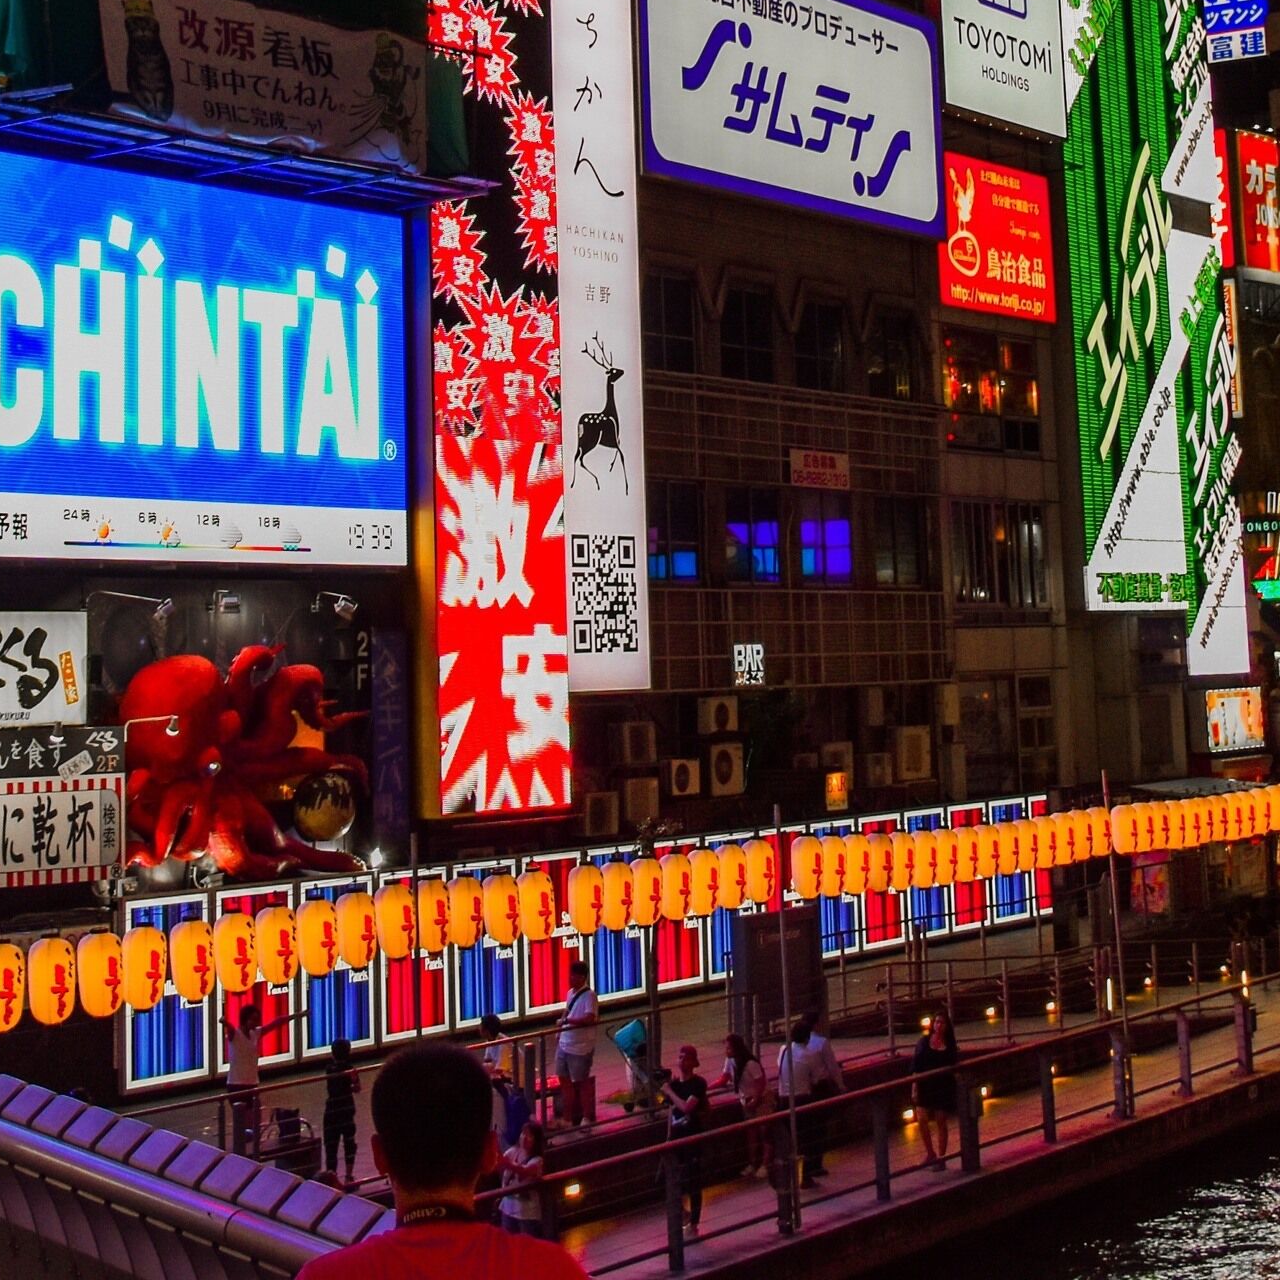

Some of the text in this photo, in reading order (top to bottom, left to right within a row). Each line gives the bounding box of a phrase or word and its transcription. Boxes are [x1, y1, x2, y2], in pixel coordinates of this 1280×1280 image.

[175, 5, 340, 81] 改源看板
[981, 64, 1030, 92] HOLDINGS
[723, 61, 875, 162] サムティ
[565, 223, 625, 245] HACHIKAN
[572, 246, 619, 264] YOSHINO
[584, 283, 612, 305] 吉野
[1086, 172, 1173, 409] エイブル
[63, 508, 91, 522] 24時
[196, 514, 221, 527] 12時
[257, 516, 282, 529] 18時
[733, 643, 765, 673] BAR
[97, 754, 120, 773] 2F
[827, 775, 847, 794] BAR
[102, 803, 116, 849] 検索
